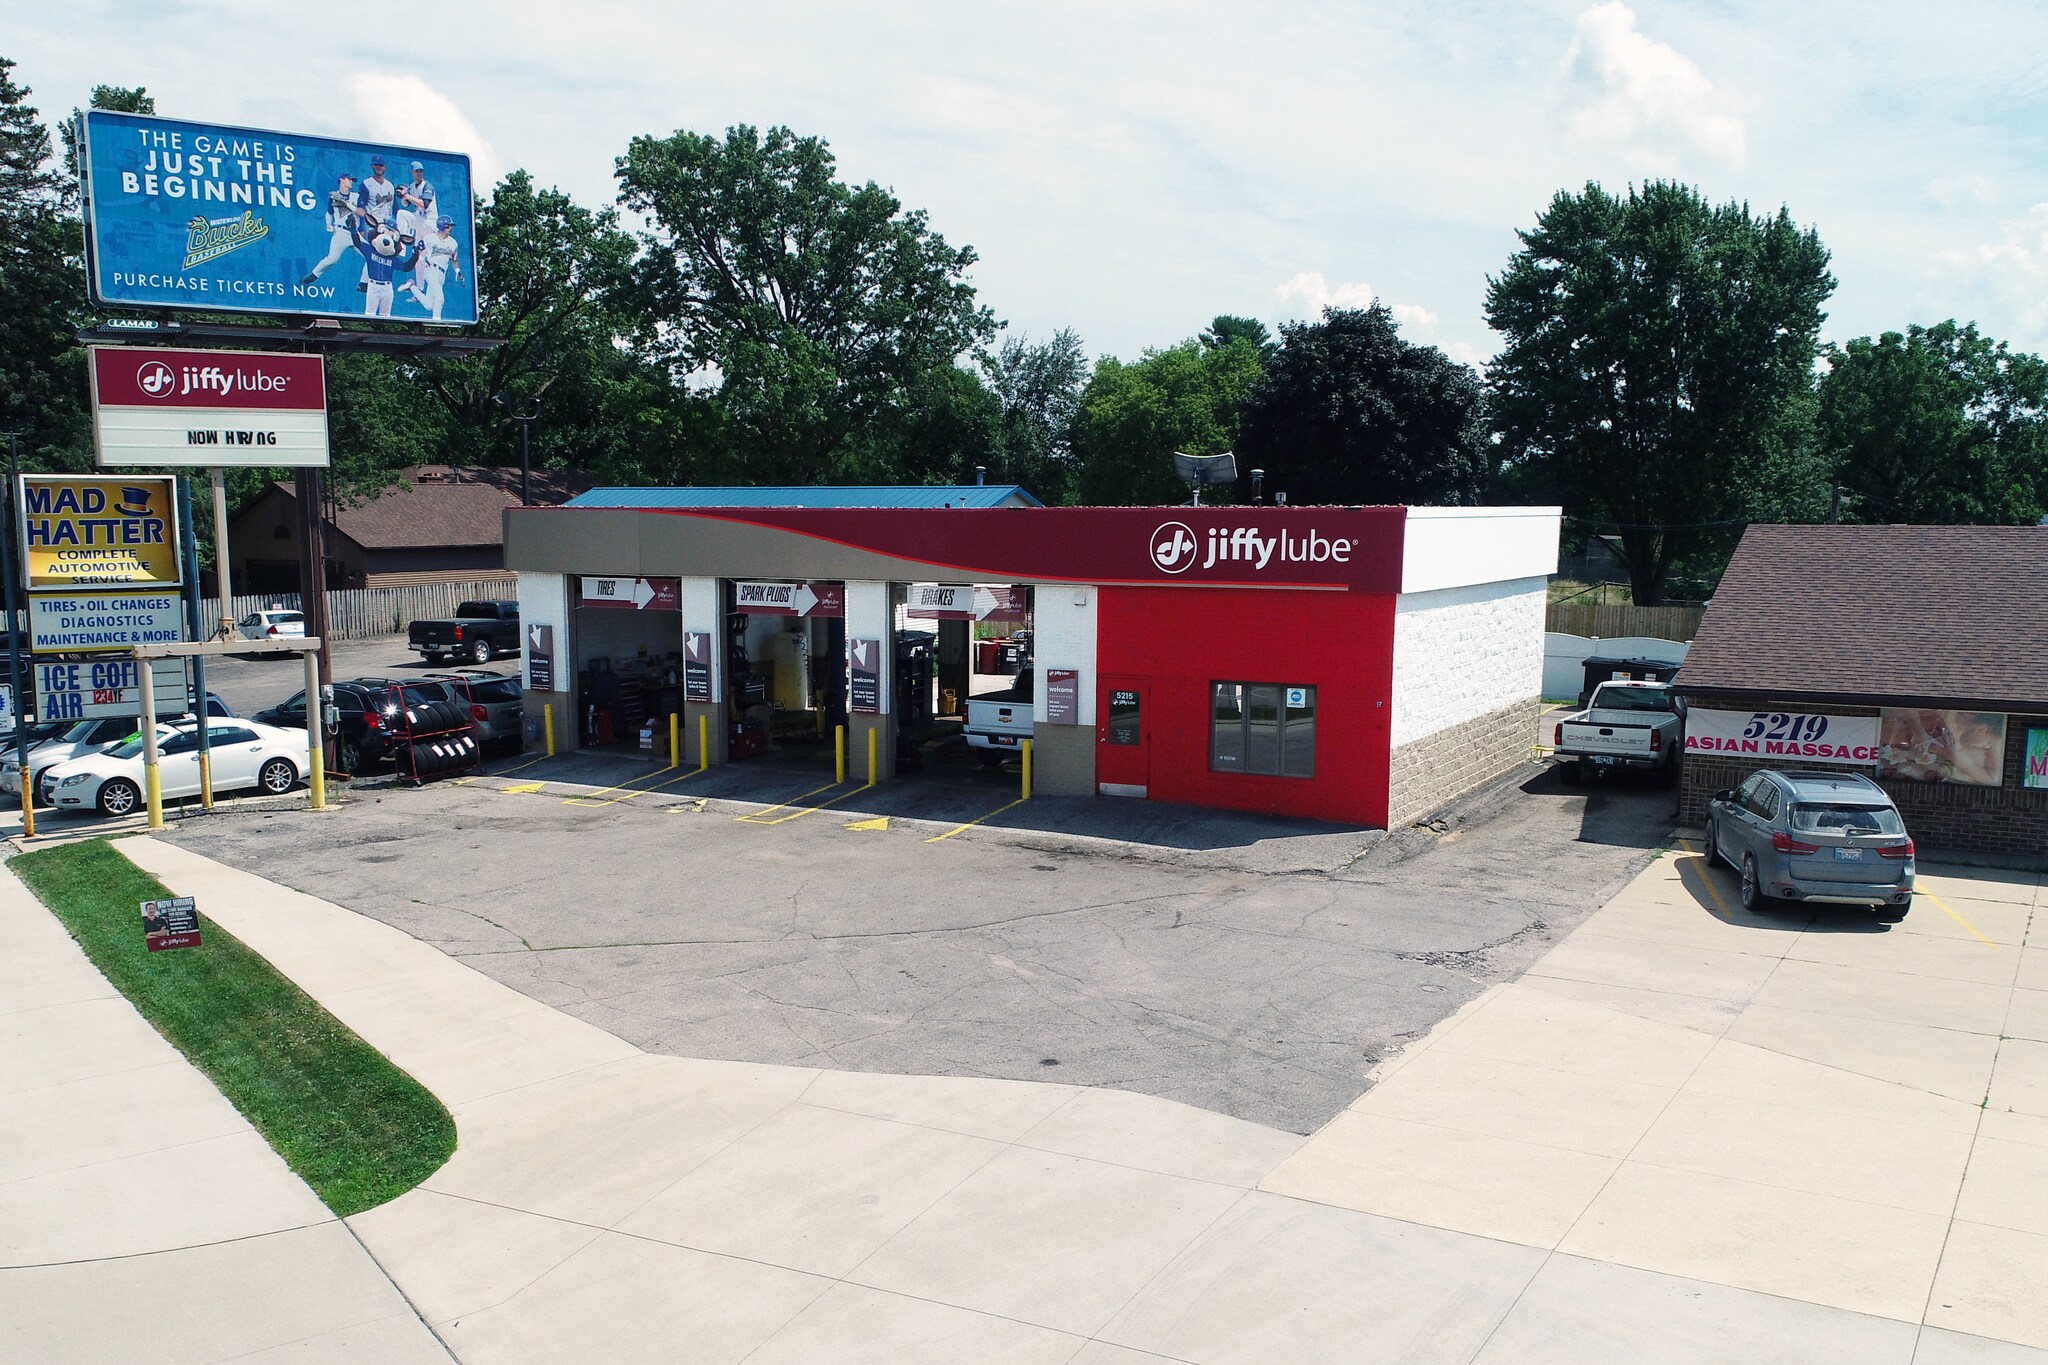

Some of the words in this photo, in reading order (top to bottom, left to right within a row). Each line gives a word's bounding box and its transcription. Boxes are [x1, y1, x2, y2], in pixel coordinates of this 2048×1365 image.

[139, 129, 182, 150] THE
[195, 136, 263, 159] GAME
[276, 144, 295, 162] IS
[144, 150, 222, 178] JUST
[237, 160, 294, 185] THE
[122, 171, 316, 211] BEGINNING
[188, 210, 268, 251] Bucks
[190, 242, 236, 262] BASEBALL
[113, 272, 209, 291] PURCHASE
[217, 279, 284, 296] TICKETS
[293, 285, 336, 299] NOW
[113, 320, 153, 329] LAMAR
[188, 430, 218, 445] NOW
[26, 487, 106, 515] MAD
[27, 518, 165, 546] HATTER
[57, 549, 137, 560] COMPLETE
[48, 561, 151, 574] AUTOMOTIVE
[71, 575, 134, 584] SERVICE
[597, 580, 616, 596] TIRES
[741, 585, 767, 601] SPARK
[766, 586, 791, 602] PLUGS
[921, 588, 955, 606] BRAKES
[40, 601, 77, 612] TIRES
[87, 600, 108, 611] OIL
[111, 599, 171, 611] CHANGES
[61, 615, 154, 629] DIAGNOSTICS
[37, 631, 127, 646] MAINTENANCE
[131, 631, 140, 642] &
[143, 630, 178, 642] MORE
[44, 665, 80, 691] ICE
[1116, 692, 1133, 700] 5215
[46, 693, 83, 720] AIR
[1744, 713, 1828, 742] 5219
[1567, 735, 1646, 745] CHEVROLET
[1684, 736, 1758, 753] ASIAN
[1766, 741, 1879, 760] MASSAGE
